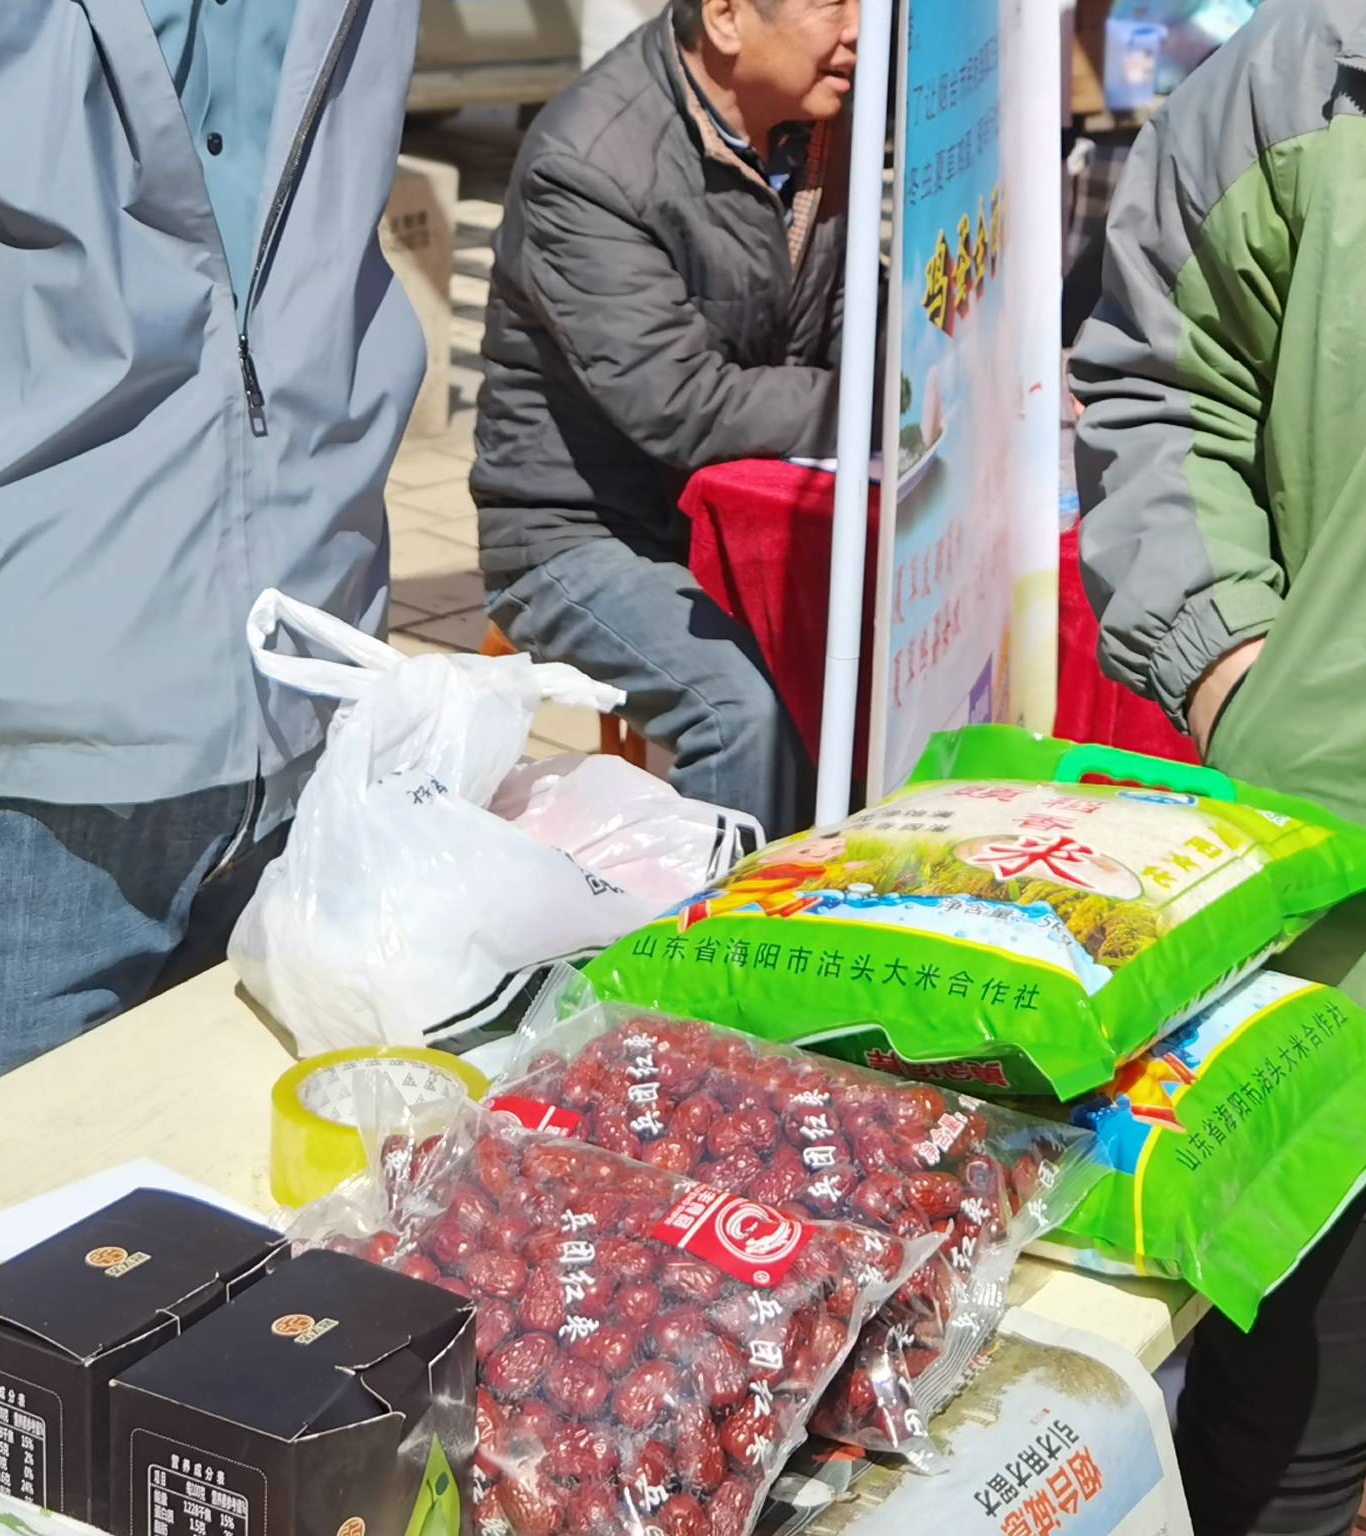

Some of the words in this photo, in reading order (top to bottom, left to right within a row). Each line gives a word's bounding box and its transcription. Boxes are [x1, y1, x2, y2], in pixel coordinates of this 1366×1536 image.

[632, 934, 1041, 1012] 山东省海阳市沽头大米合作社
[1175, 1000, 1349, 1172] 山东省海阳市沽头大米合作社
[558, 1208, 600, 1343] 兵团红枣
[745, 1290, 783, 1465] 兵团红枣
[974, 1419, 1080, 1518] 引才用才留才
